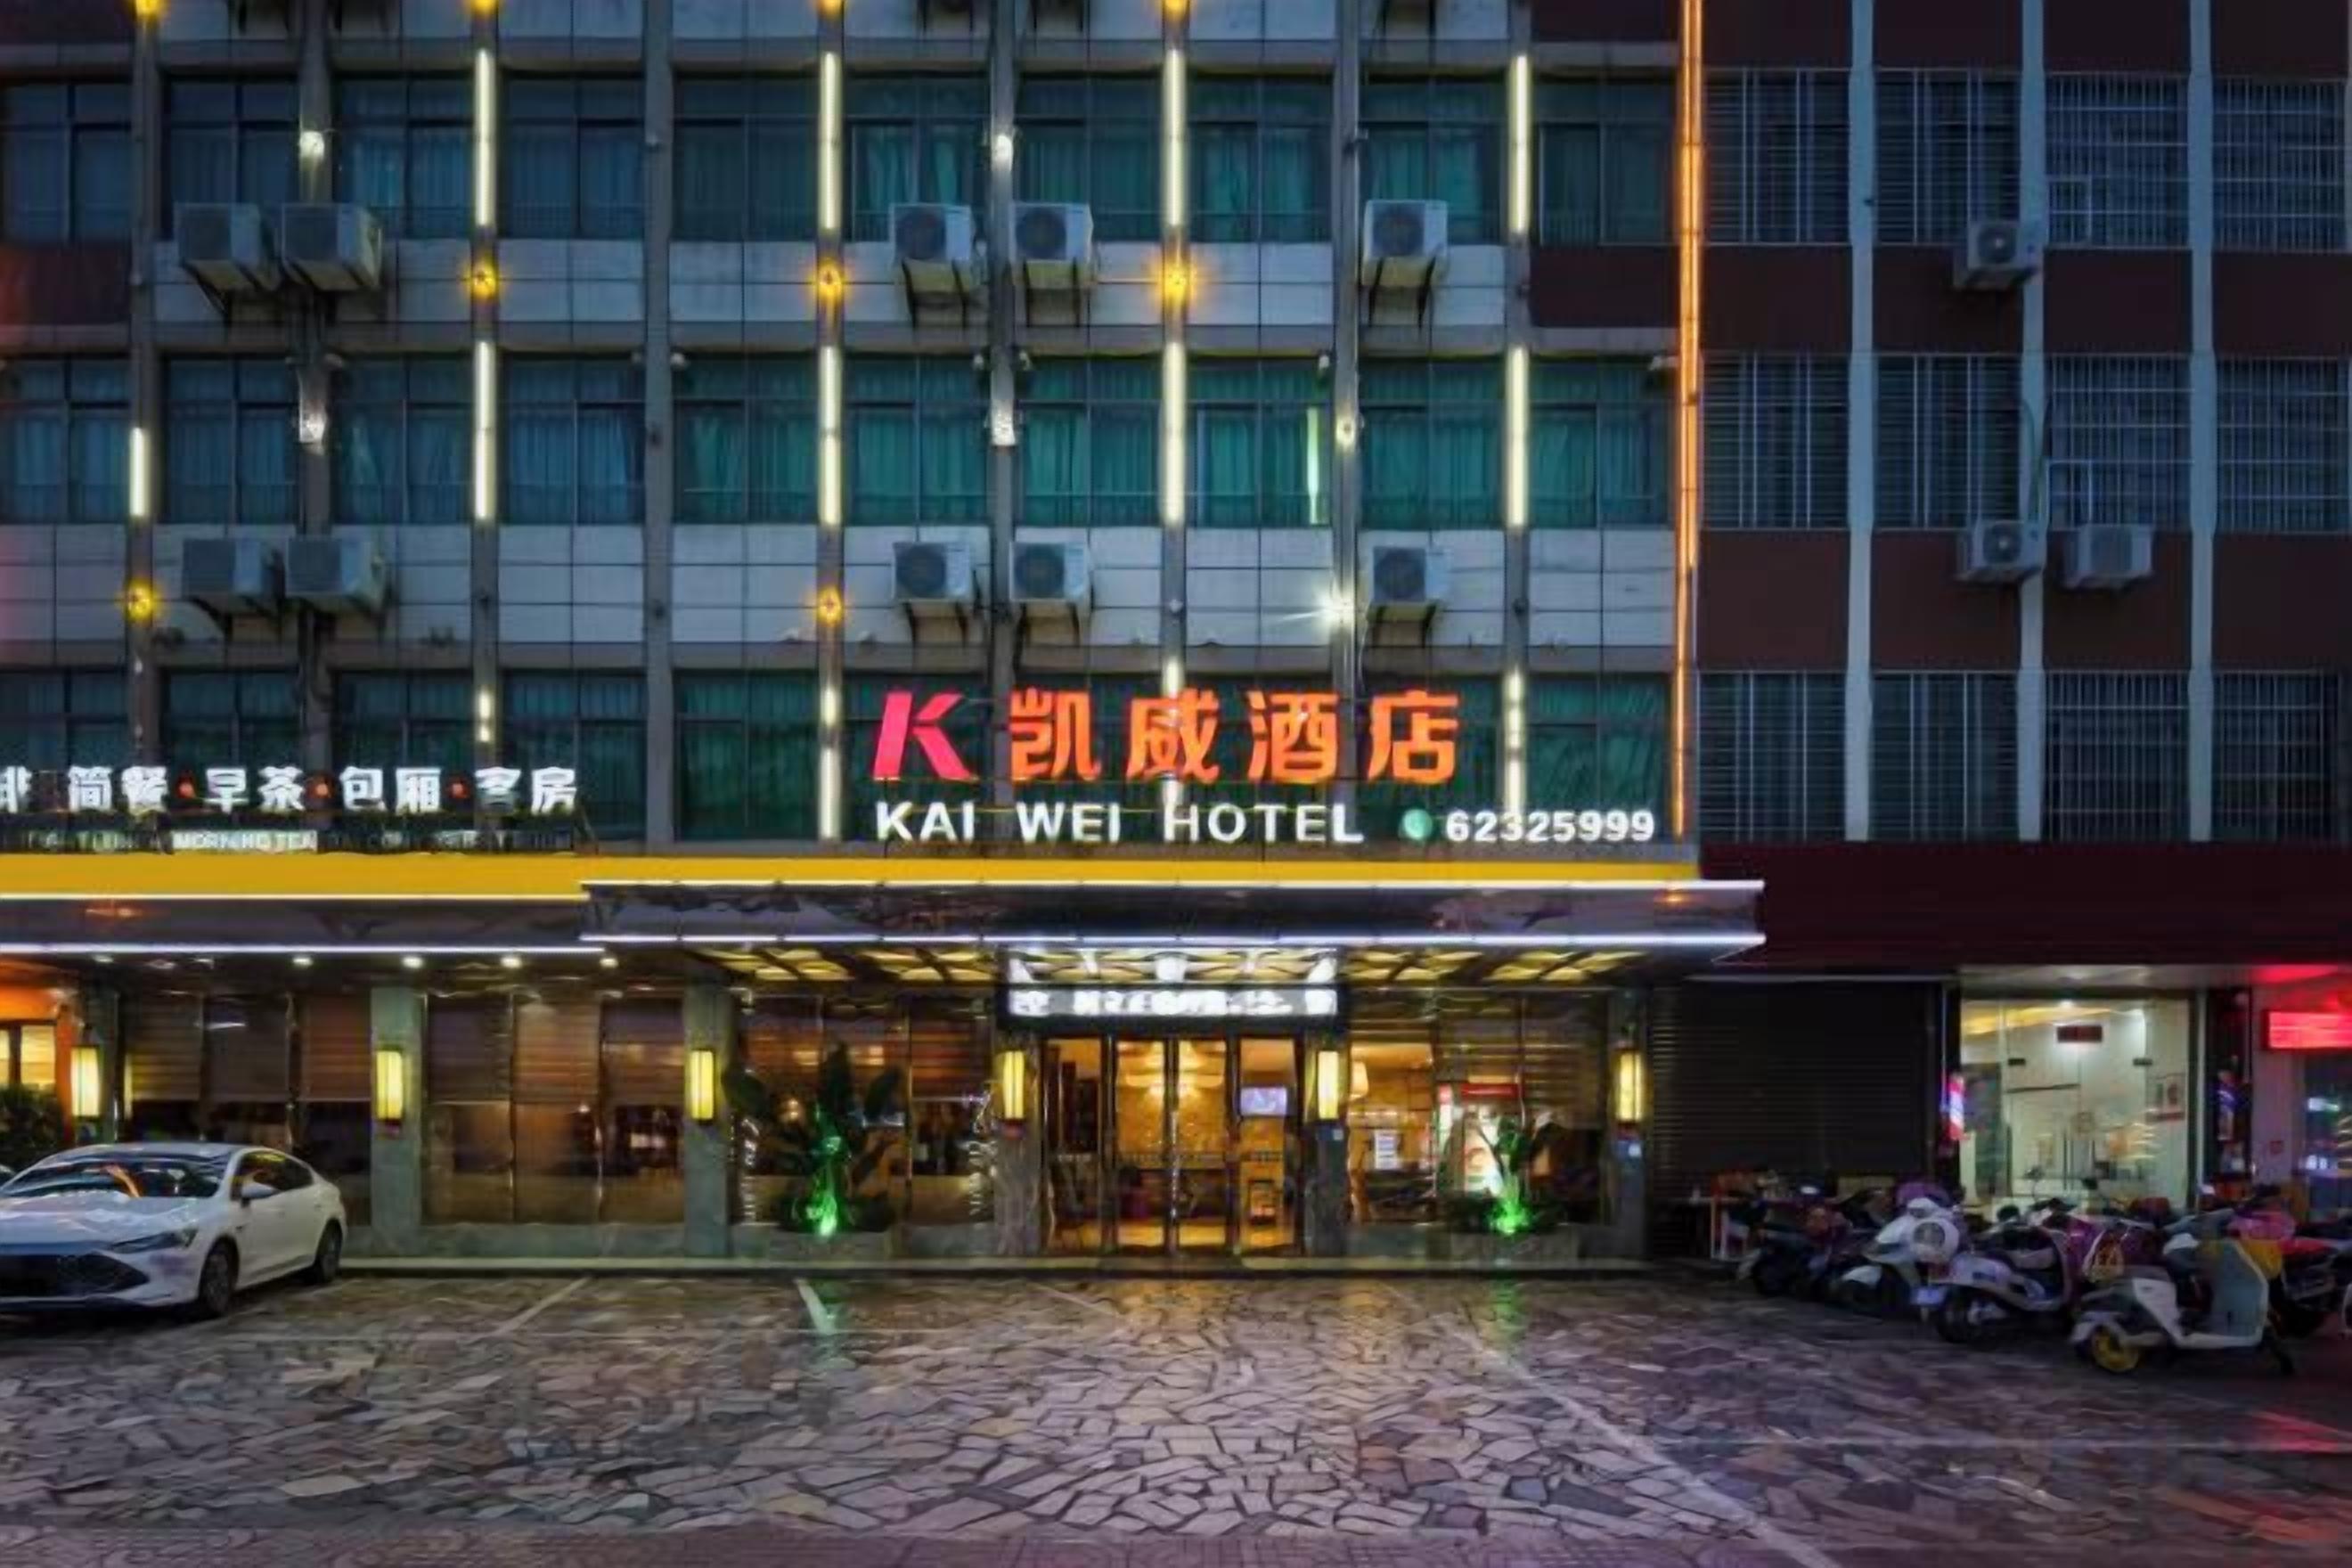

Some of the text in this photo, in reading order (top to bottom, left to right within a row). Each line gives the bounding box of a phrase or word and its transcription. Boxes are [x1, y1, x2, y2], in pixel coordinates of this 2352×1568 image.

[872, 690, 978, 781] K
[1009, 687, 1459, 786] 凯威酒店
[876, 801, 1364, 843] KAI WEI HOTEL
[1445, 809, 1655, 842] 62325999
